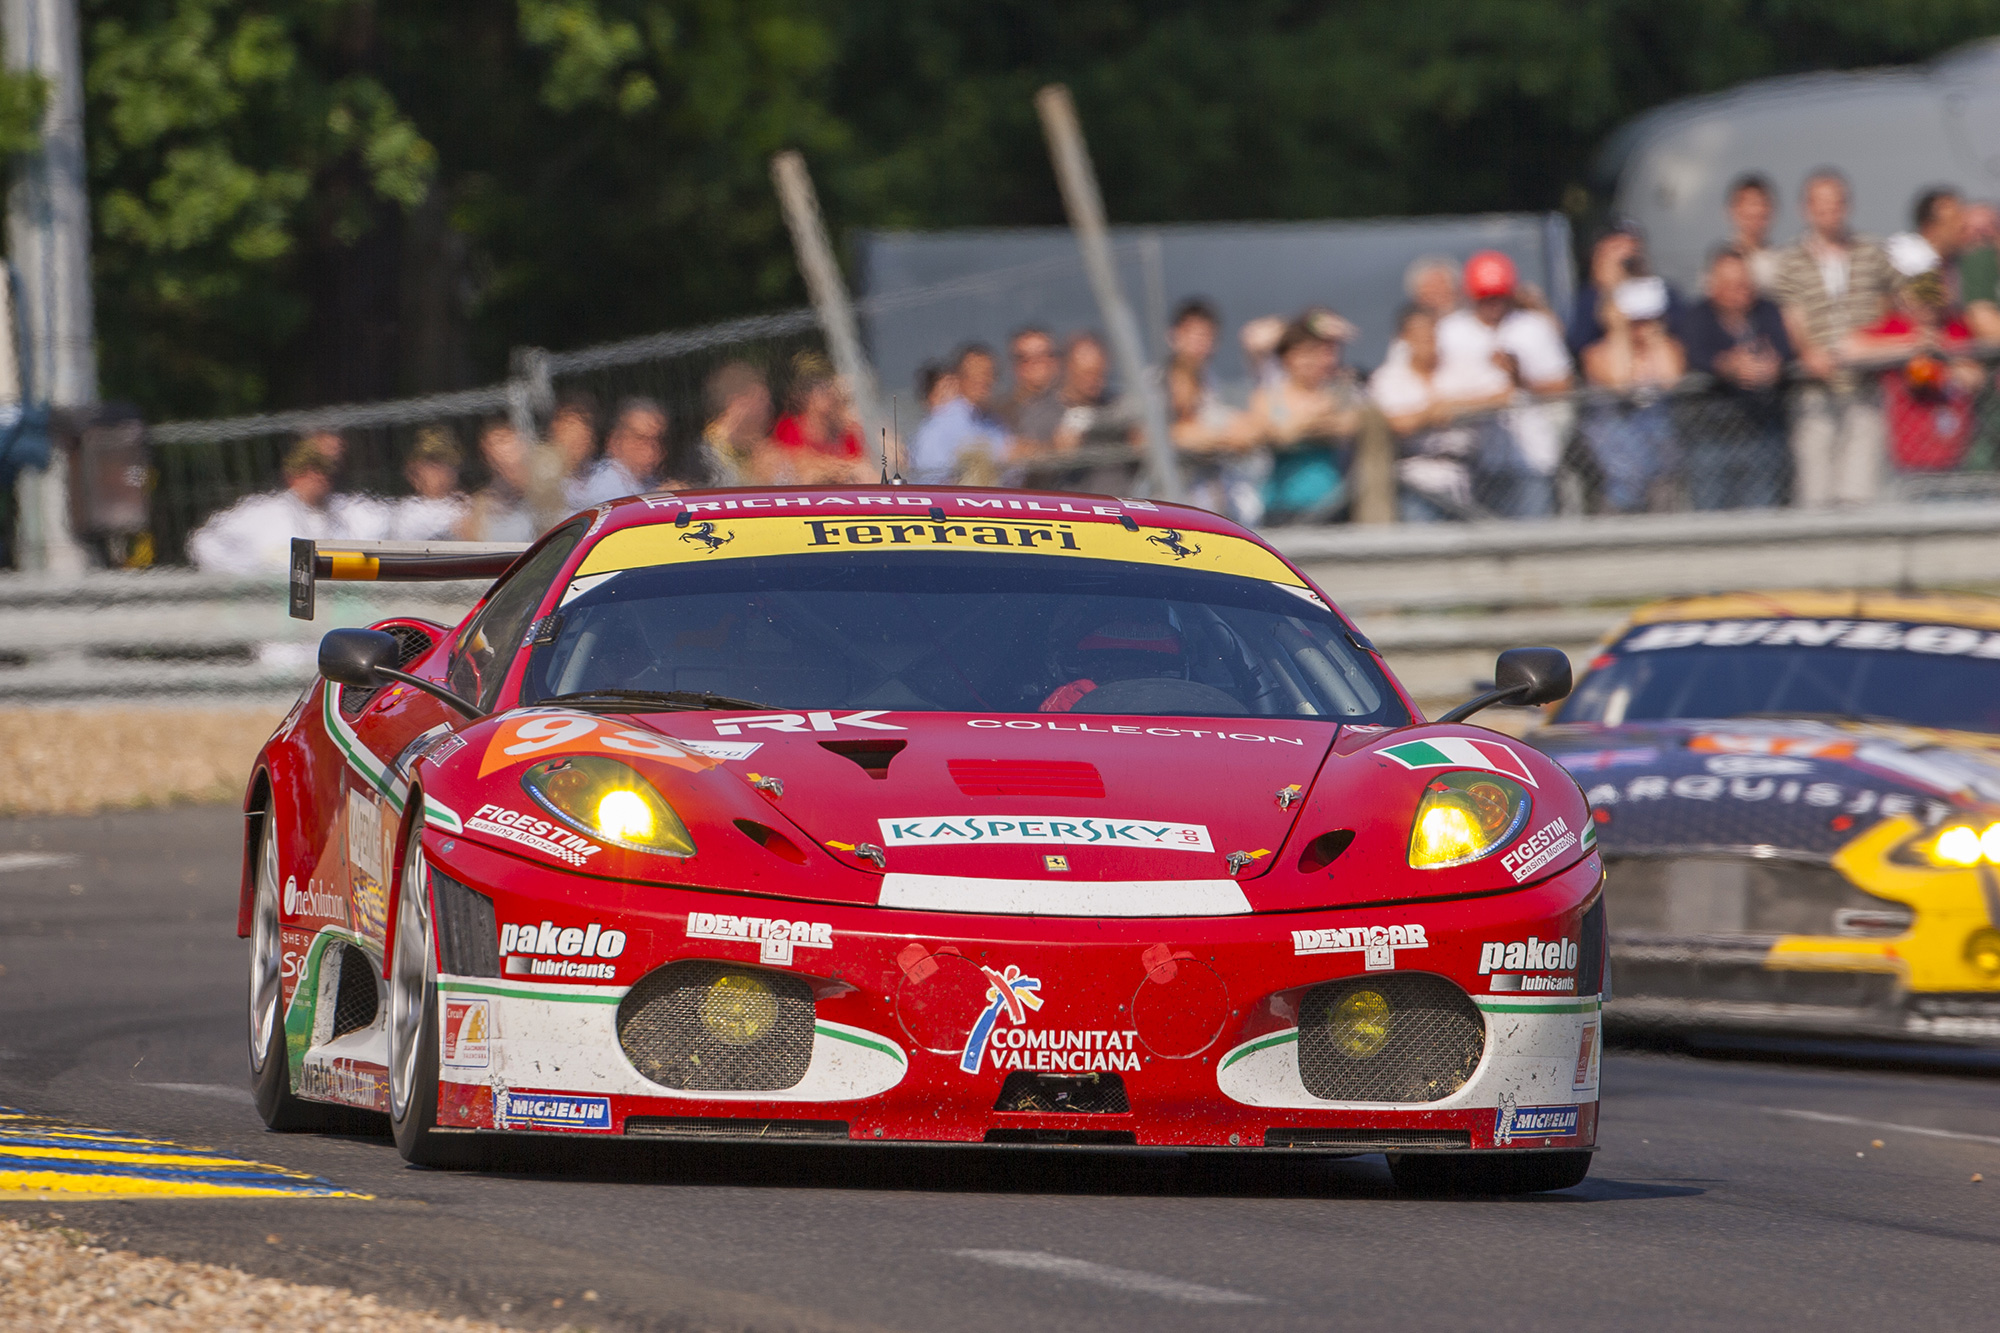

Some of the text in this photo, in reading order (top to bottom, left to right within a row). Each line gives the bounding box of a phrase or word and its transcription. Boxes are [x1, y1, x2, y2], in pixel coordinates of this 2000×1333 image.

[685, 496, 933, 513] RICHARD
[956, 497, 1124, 518] MILLE
[803, 519, 1081, 551] Ferrari
[711, 710, 1304, 746] RK COLLECTION
[467, 817, 560, 854] Leasing Monza
[473, 803, 602, 856] FIGESTIM
[891, 818, 1172, 842] KASPERSKY
[1500, 816, 1568, 873] FIGESTIM
[1513, 839, 1568, 880] Leasing Monza
[282, 931, 310, 947] SHE'S
[498, 920, 628, 959] pakelo
[686, 911, 833, 947] IDENTICAR
[1291, 923, 1429, 951] IDENTICAR
[529, 956, 617, 980] lubricants
[1477, 935, 1579, 976] pakelo
[1520, 974, 1575, 991] lubricants
[990, 1028, 1138, 1050] COMUNITAT
[990, 1050, 1142, 1072] VALENCIANA
[511, 1098, 605, 1120] MICHELIN
[1516, 1112, 1578, 1129] MICHELIN
